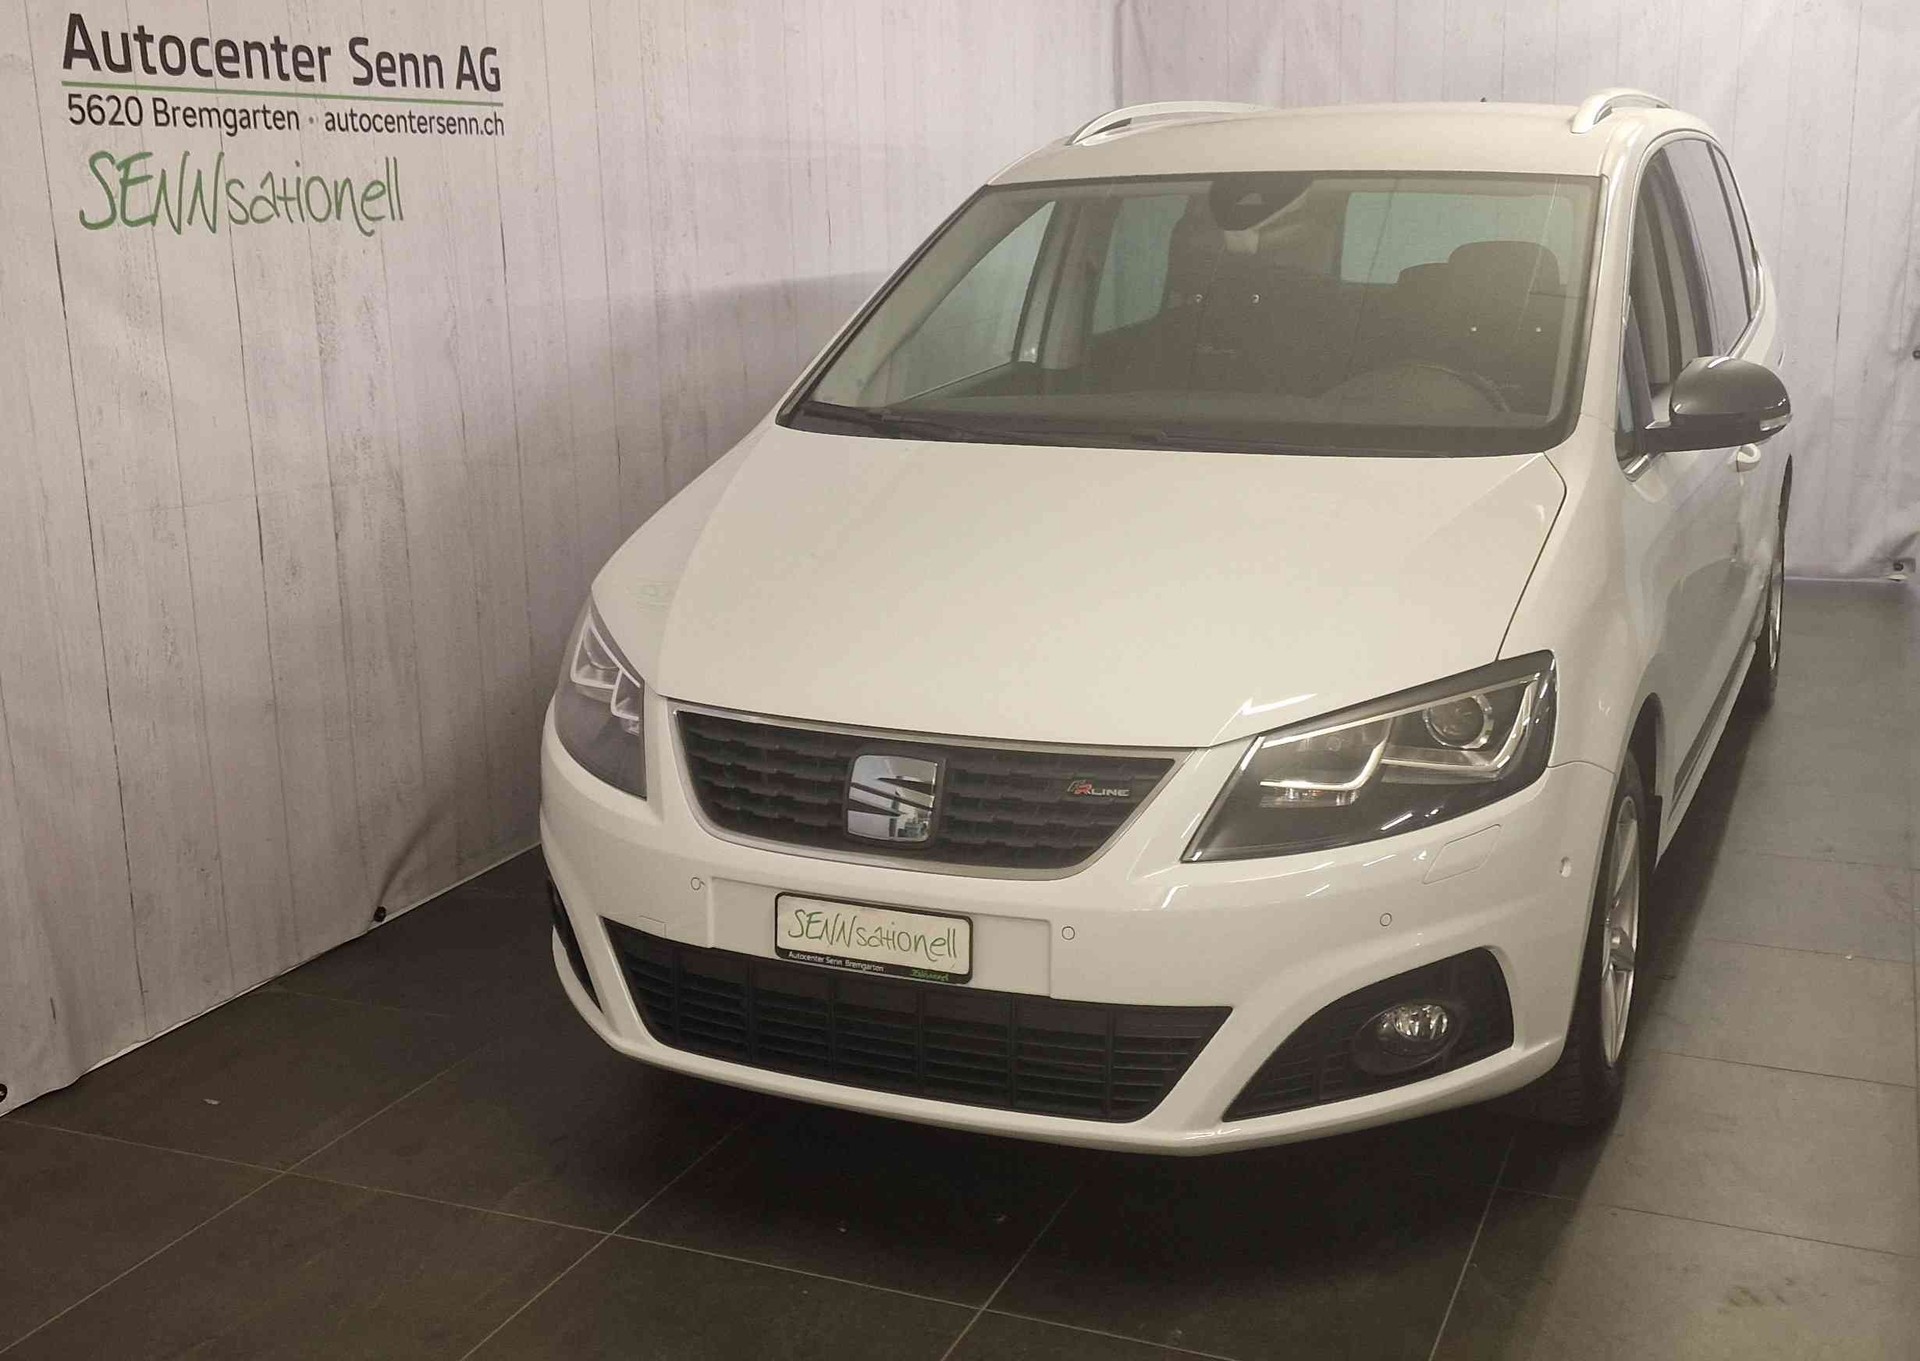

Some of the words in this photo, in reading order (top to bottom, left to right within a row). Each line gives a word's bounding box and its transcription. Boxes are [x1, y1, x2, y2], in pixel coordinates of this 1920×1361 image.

[62, 12, 332, 83] Autocenter
[348, 37, 444, 89] Senn
[455, 45, 502, 92] AG
[68, 93, 143, 126] 5620
[153, 97, 300, 136] Bremgarten
[324, 108, 505, 137] autocentersenn.ch
[79, 150, 404, 237] SENNsationell
[788, 909, 958, 962] SENNsationell
[788, 951, 825, 963] Autocenter
[825, 956, 843, 967] Senn
[845, 959, 885, 973] Bremgarten
